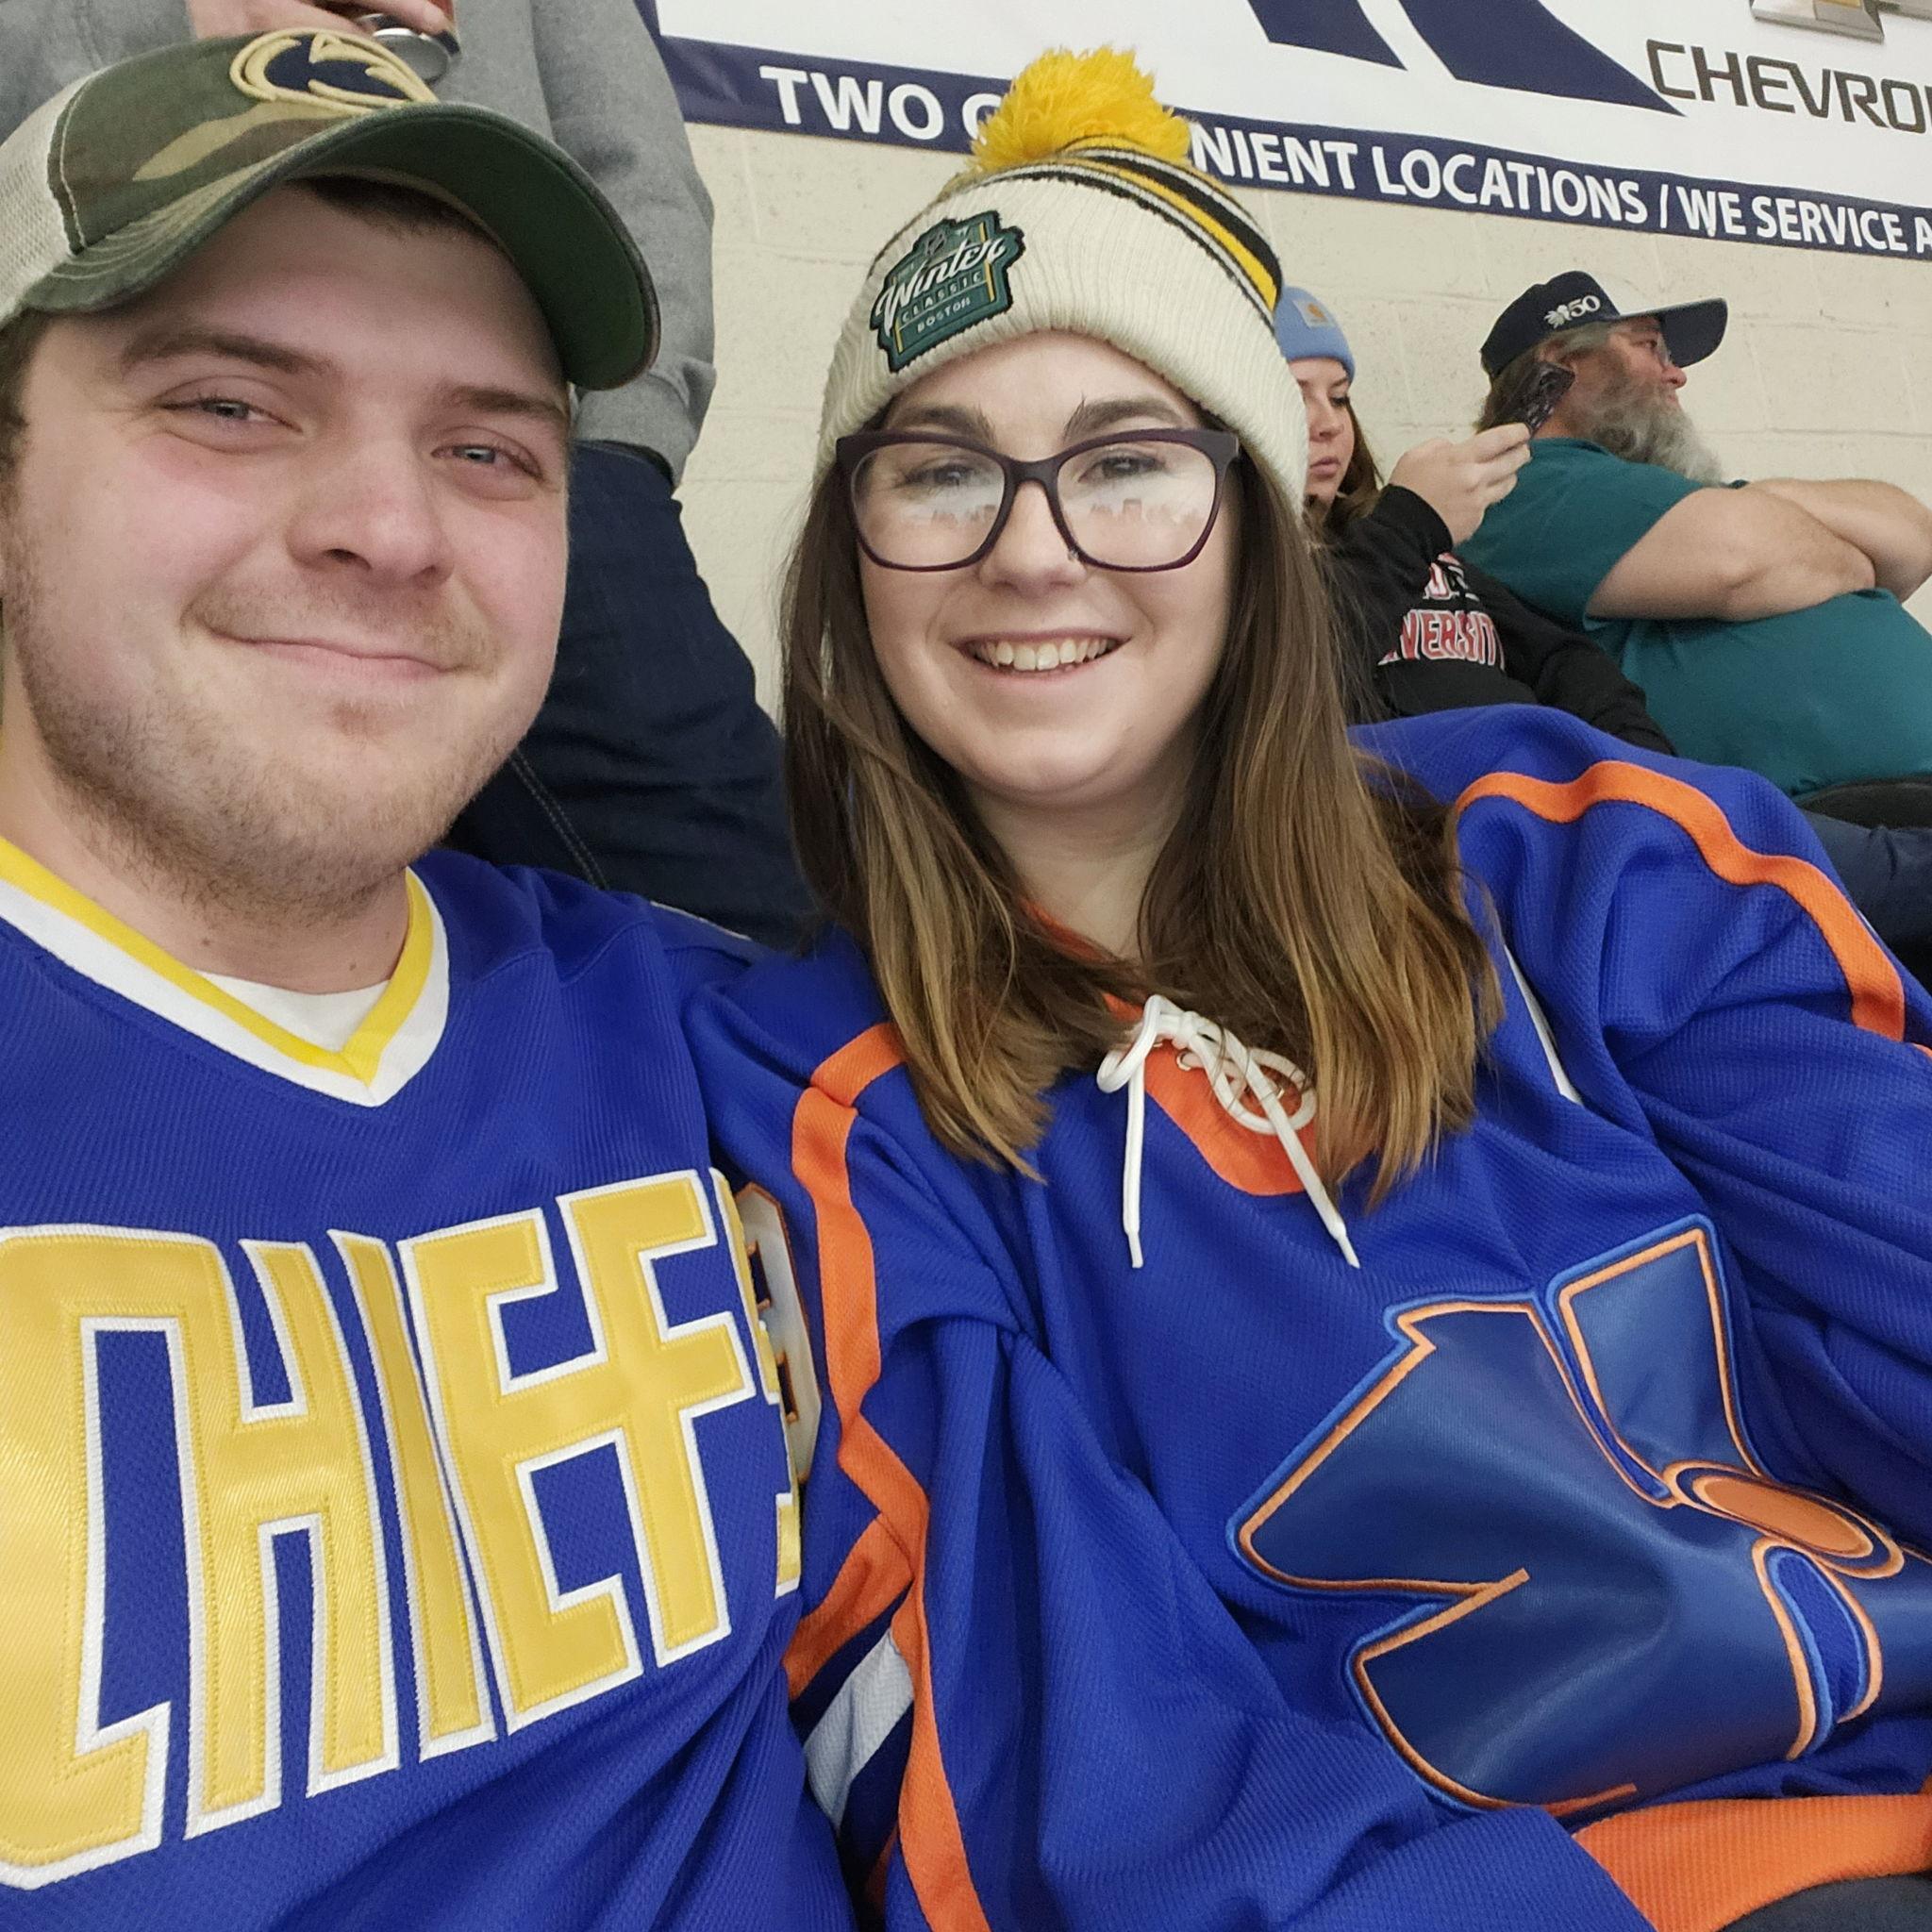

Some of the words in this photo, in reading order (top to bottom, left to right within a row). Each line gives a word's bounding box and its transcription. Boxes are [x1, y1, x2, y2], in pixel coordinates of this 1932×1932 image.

[758, 65, 944, 141] TWO
[1372, 145, 1648, 225] LOCATIONS
[1675, 186, 1746, 237] WE
[1751, 195, 1908, 252] SERVICE
[874, 238, 1007, 338] Winter
[902, 271, 982, 323] CLASSIC
[917, 297, 971, 333] BOSTON
[1568, 294, 1601, 318] 50
[1377, 608, 1505, 672] VERSIT
